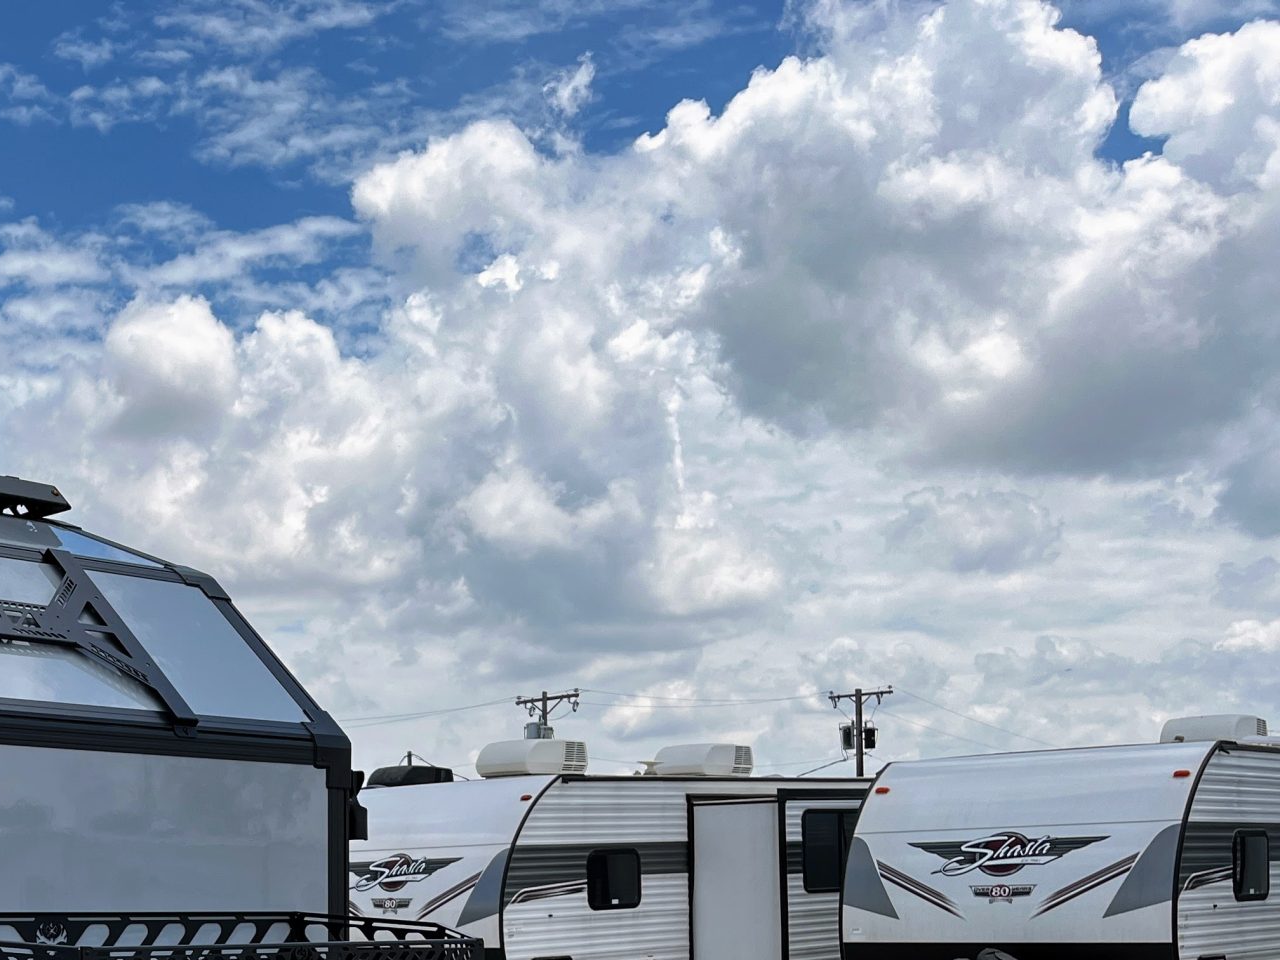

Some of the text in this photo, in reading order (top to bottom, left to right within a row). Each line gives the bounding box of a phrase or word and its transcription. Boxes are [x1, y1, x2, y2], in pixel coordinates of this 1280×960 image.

[940, 834, 1052, 876] Shasta
[355, 855, 427, 891] Shasta
[992, 886, 1009, 897] 80
[384, 899, 396, 909] 80
